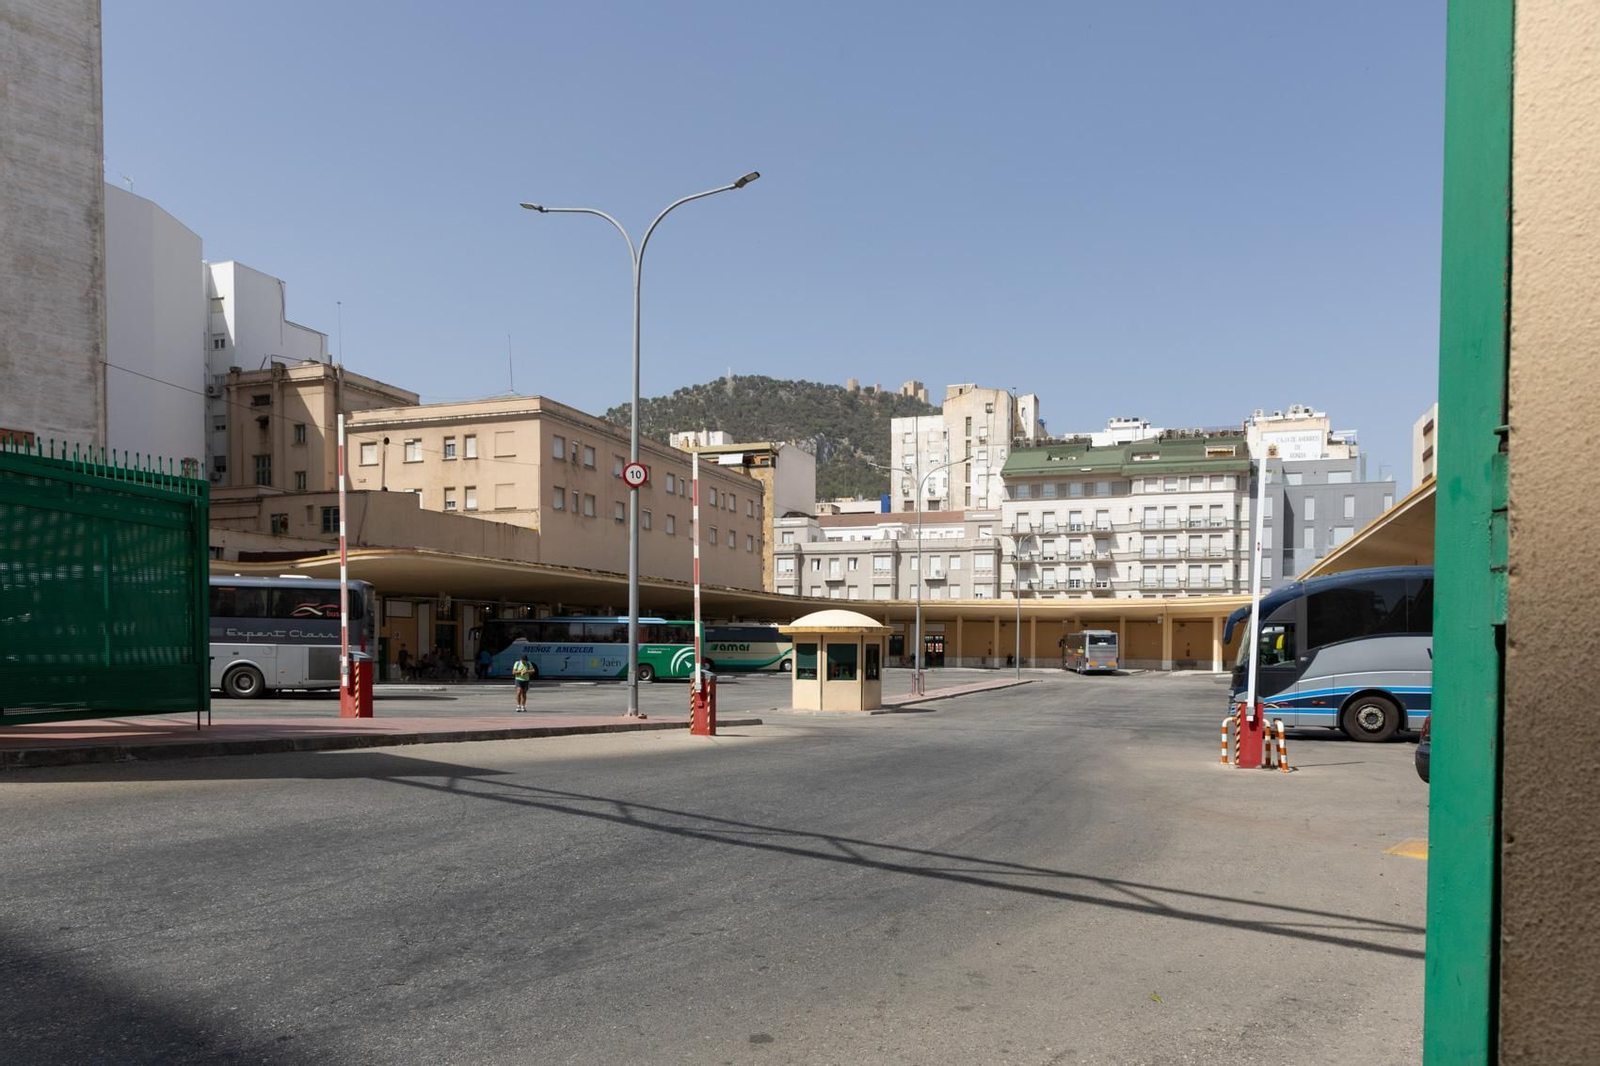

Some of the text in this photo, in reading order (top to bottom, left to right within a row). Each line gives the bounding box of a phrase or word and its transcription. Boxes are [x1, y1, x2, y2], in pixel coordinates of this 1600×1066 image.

[630, 470, 642, 479] 10
[226, 628, 339, 643] Expert Class
[522, 644, 594, 653] MUÑOZ AMEZCUA
